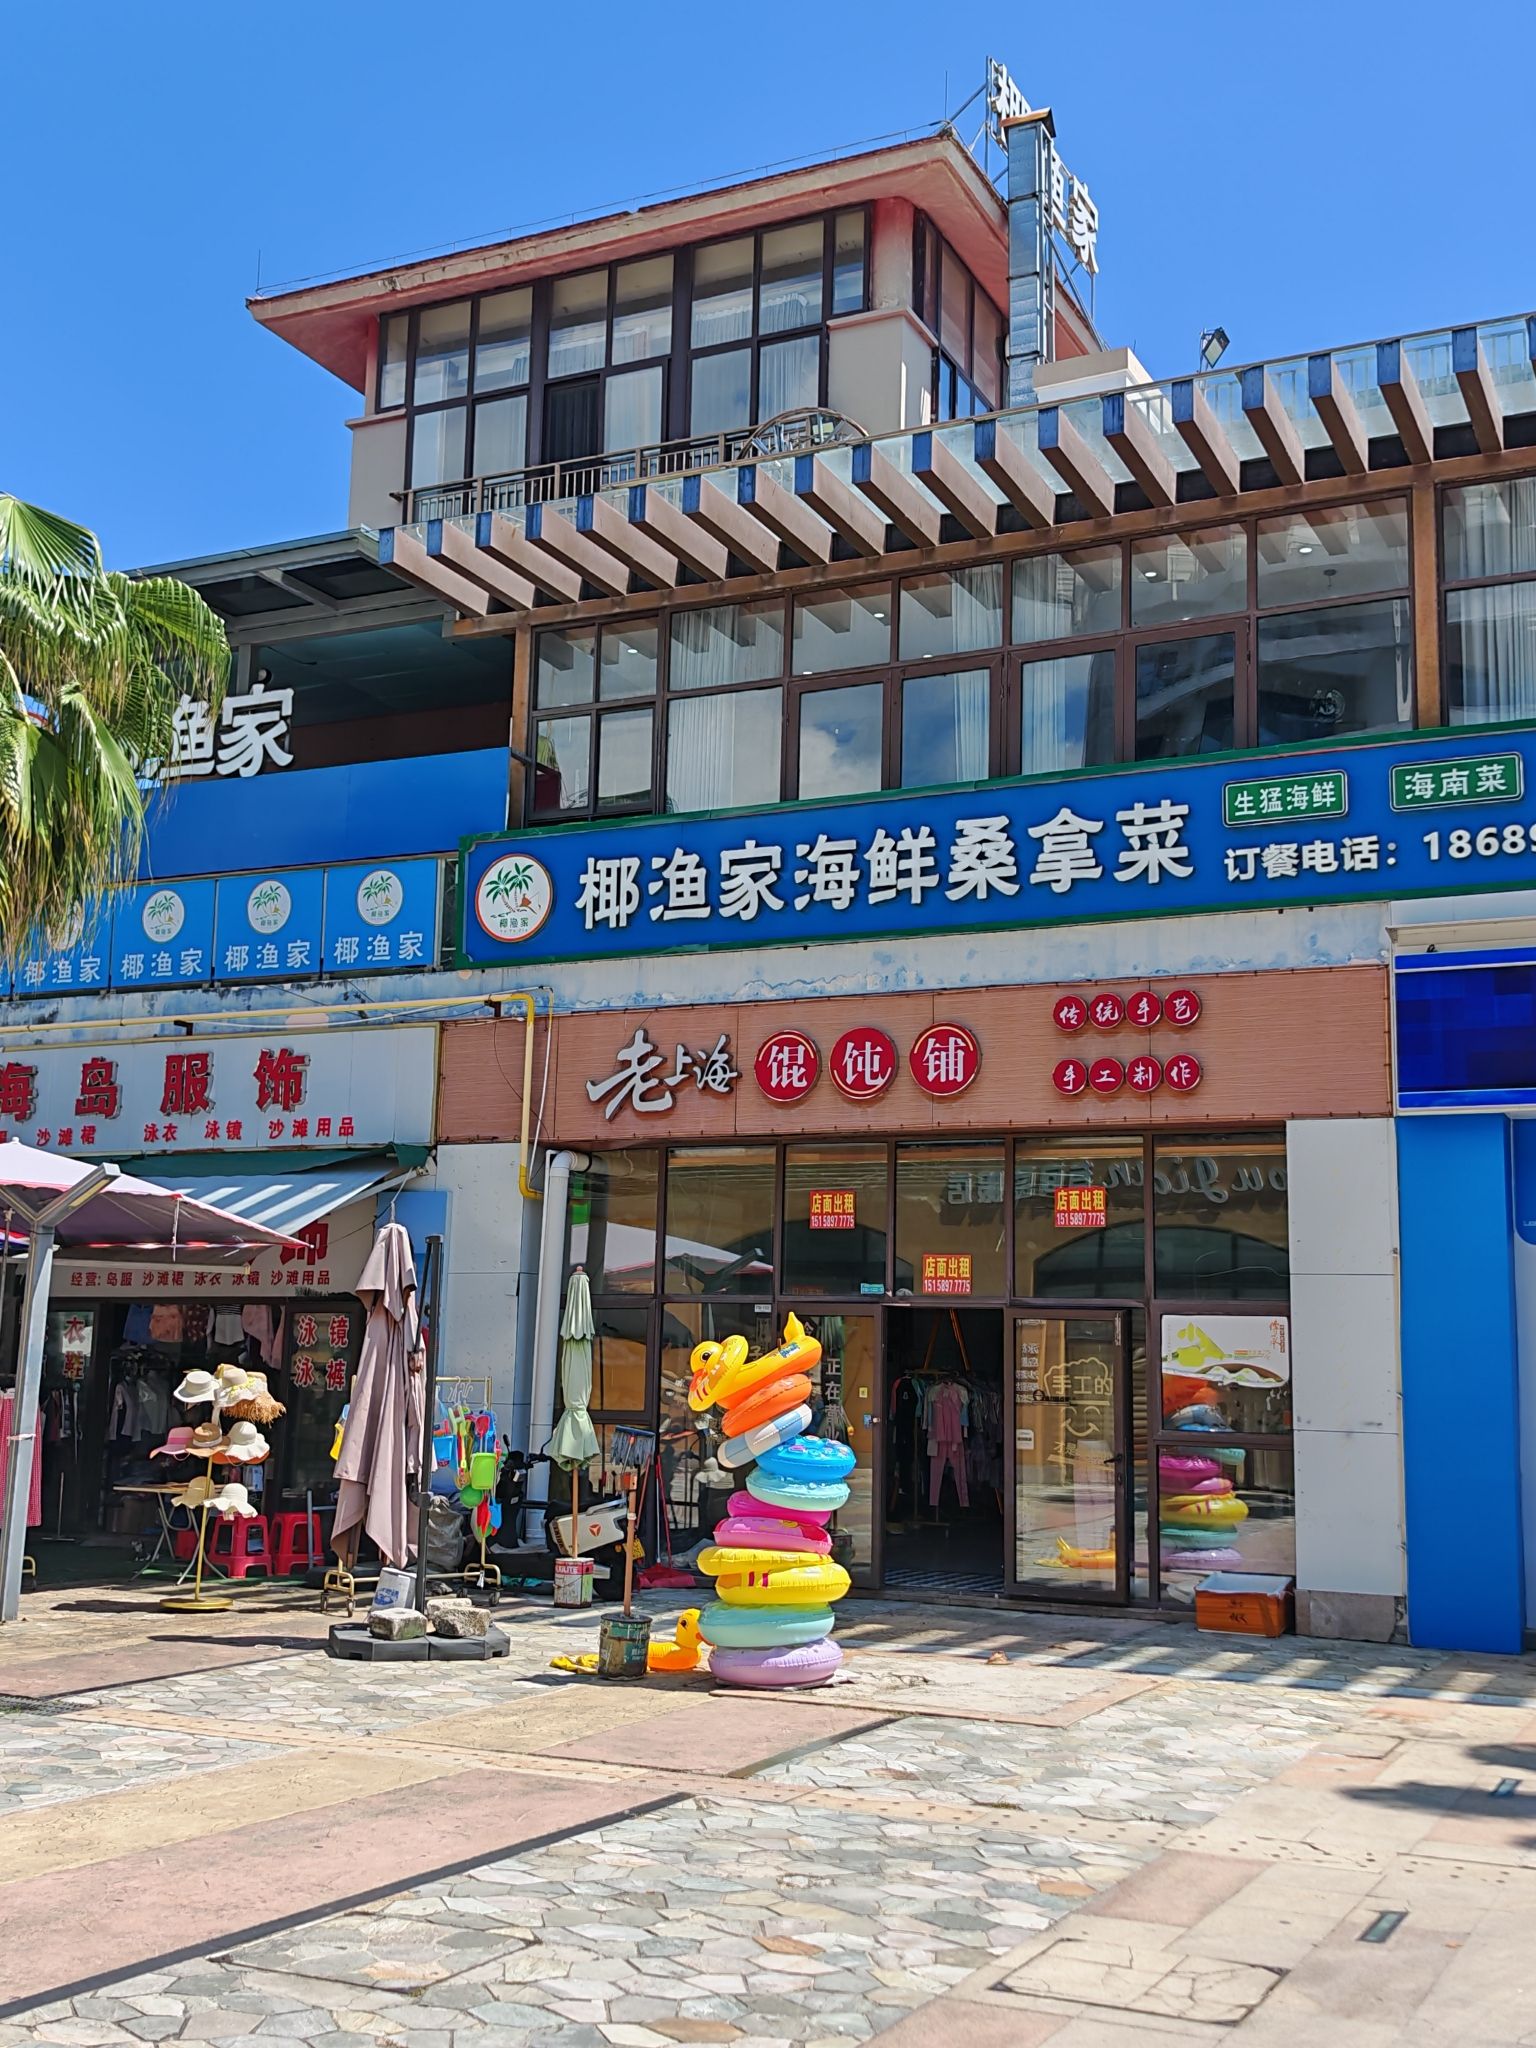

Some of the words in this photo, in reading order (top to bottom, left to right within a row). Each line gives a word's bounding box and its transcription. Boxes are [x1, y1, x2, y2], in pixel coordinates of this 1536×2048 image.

[1404, 764, 1508, 800] 海南菜
[1234, 781, 1337, 817] 生猛海鲜
[574, 799, 1194, 930] 椰渔家海鲜桑拿菜
[120, 948, 203, 981] 椰渔家
[224, 939, 311, 973] 椰渔家
[334, 931, 424, 965] 椰渔家
[1059, 995, 1191, 1026] 传统手艺
[0, 1049, 309, 1121] 海岛服饰
[1062, 1061, 1192, 1091] 手工制作
[36, 1125, 97, 1147] 沙滩裙
[143, 1123, 178, 1143] 泳衣
[204, 1120, 243, 1141] 泳镜
[268, 1116, 355, 1140] 沙滩用品
[811, 1193, 854, 1213] 店面出租
[1057, 1189, 1105, 1211] 店面出租
[142, 1271, 184, 1286] 沙滩裙
[270, 1270, 330, 1285] 沙滩用品
[925, 1257, 970, 1278] 店面出租
[297, 1314, 349, 1348] 泳镜
[294, 1355, 347, 1391] 泳裤
[1053, 1375, 1113, 1396] 手工的
